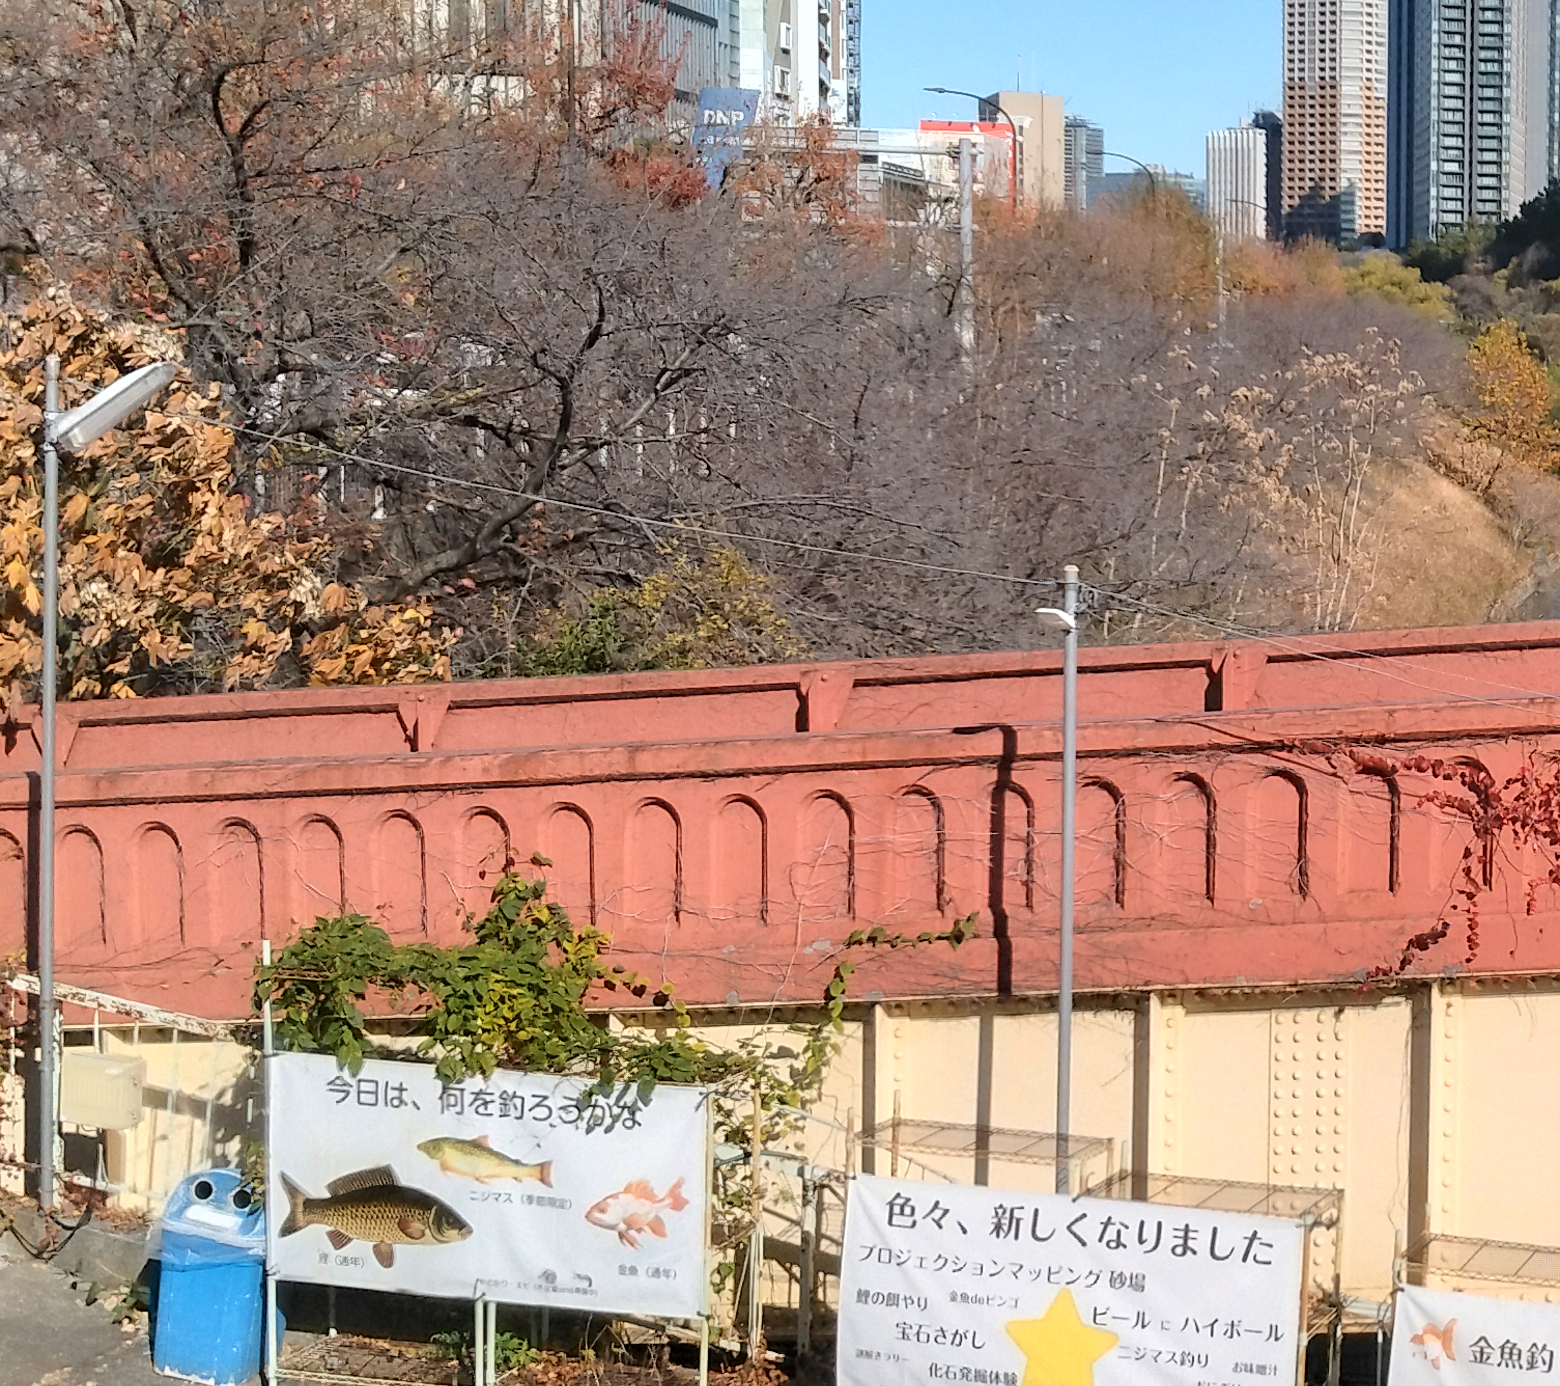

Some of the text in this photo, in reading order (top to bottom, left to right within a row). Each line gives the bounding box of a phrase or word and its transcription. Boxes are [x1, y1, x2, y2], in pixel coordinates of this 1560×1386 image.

[885, 1192, 1275, 1266] 色々、新しくなりました
[895, 1321, 987, 1350] 宝石さがし
